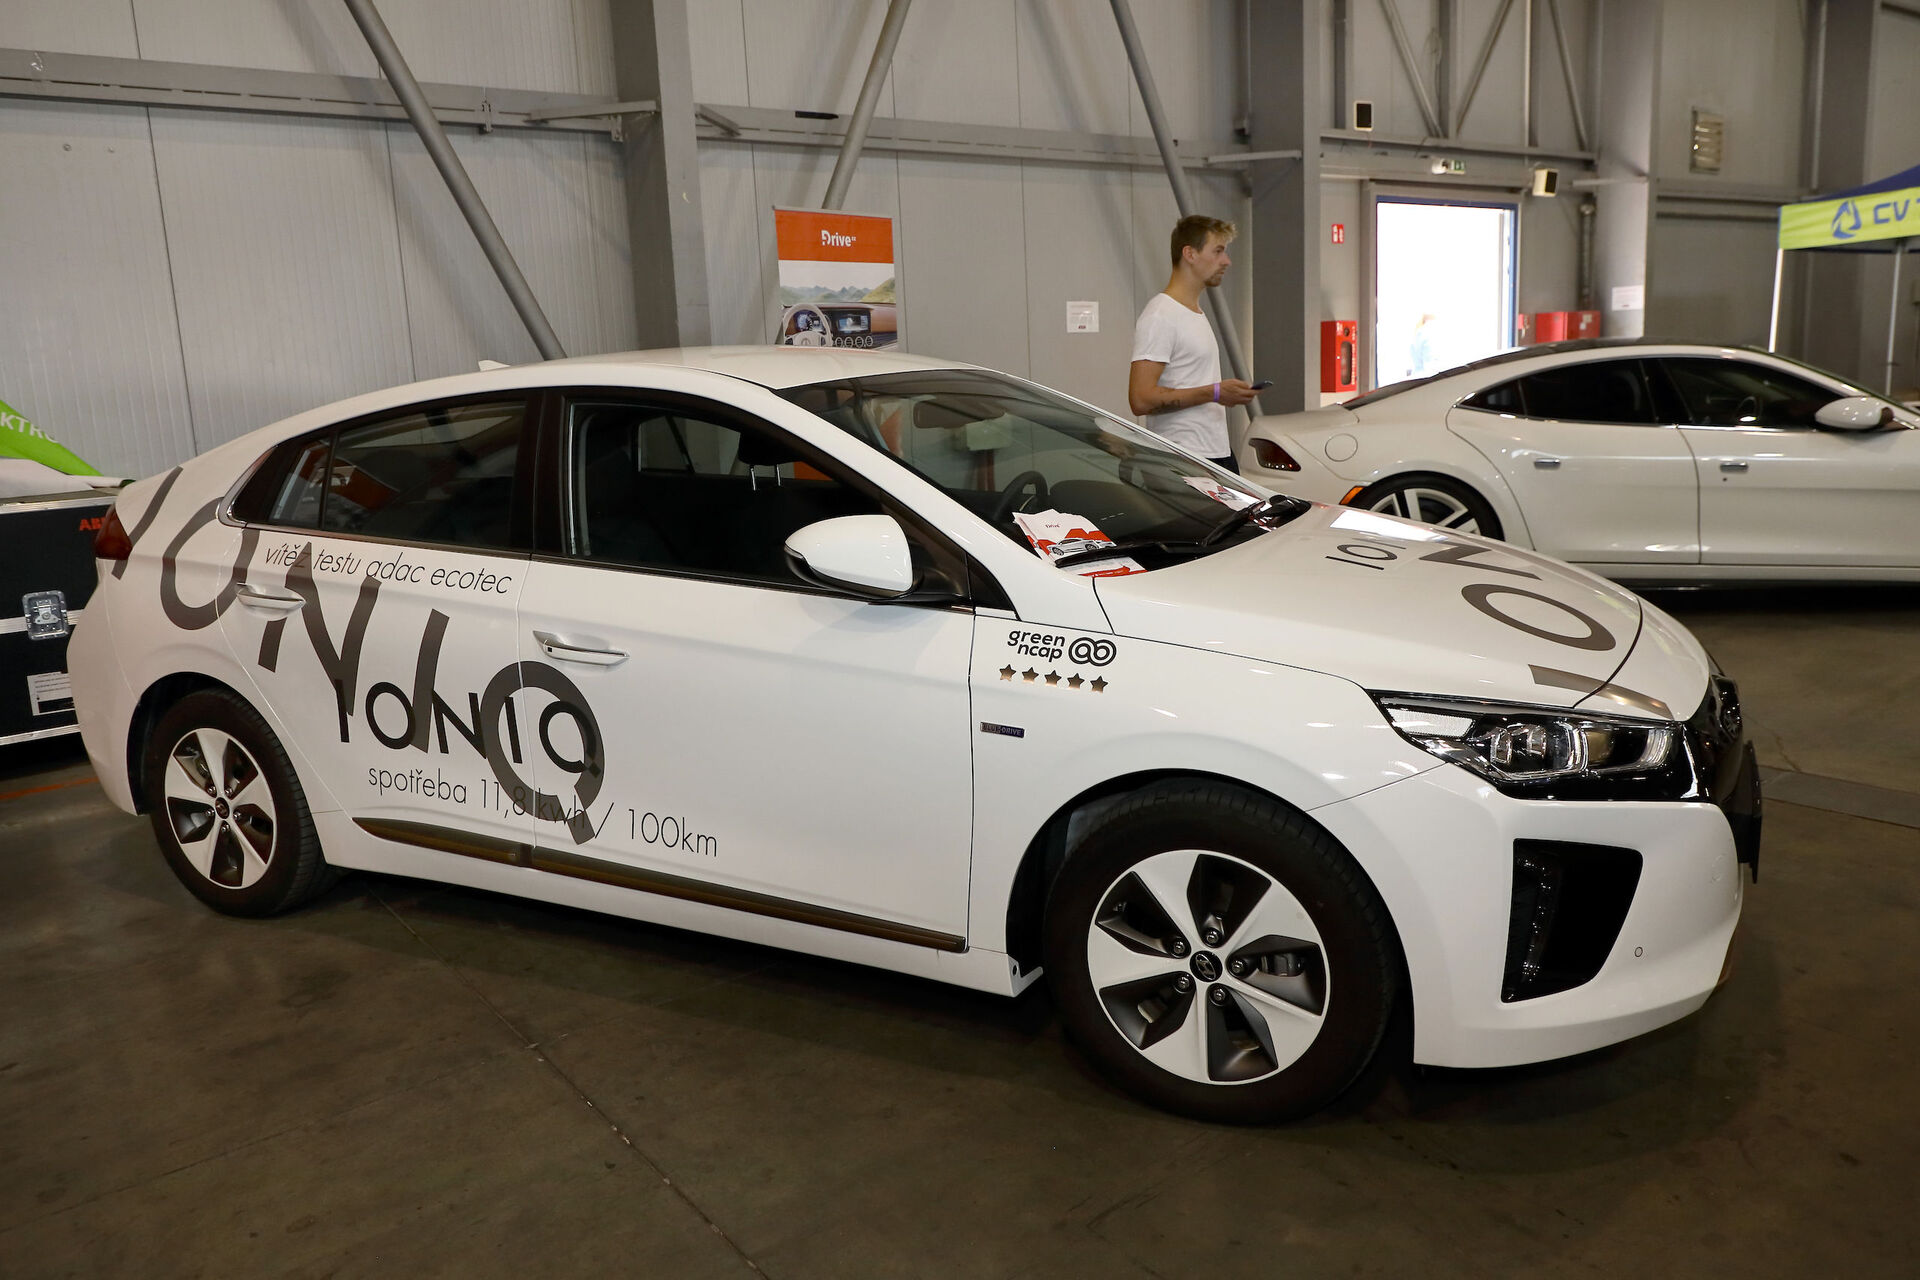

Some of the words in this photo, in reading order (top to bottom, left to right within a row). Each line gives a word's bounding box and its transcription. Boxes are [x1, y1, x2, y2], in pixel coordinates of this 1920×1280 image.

[1873, 199, 1910, 225] CV
[313, 548, 362, 575] testu
[365, 552, 425, 583] adac
[430, 568, 512, 594] ecotec
[1007, 630, 1066, 647] green
[1017, 644, 1063, 662] ncap
[334, 679, 601, 779] IONIQ
[369, 767, 467, 804] spotřeba
[481, 779, 526, 818] 11,8
[628, 808, 717, 857] 100km
